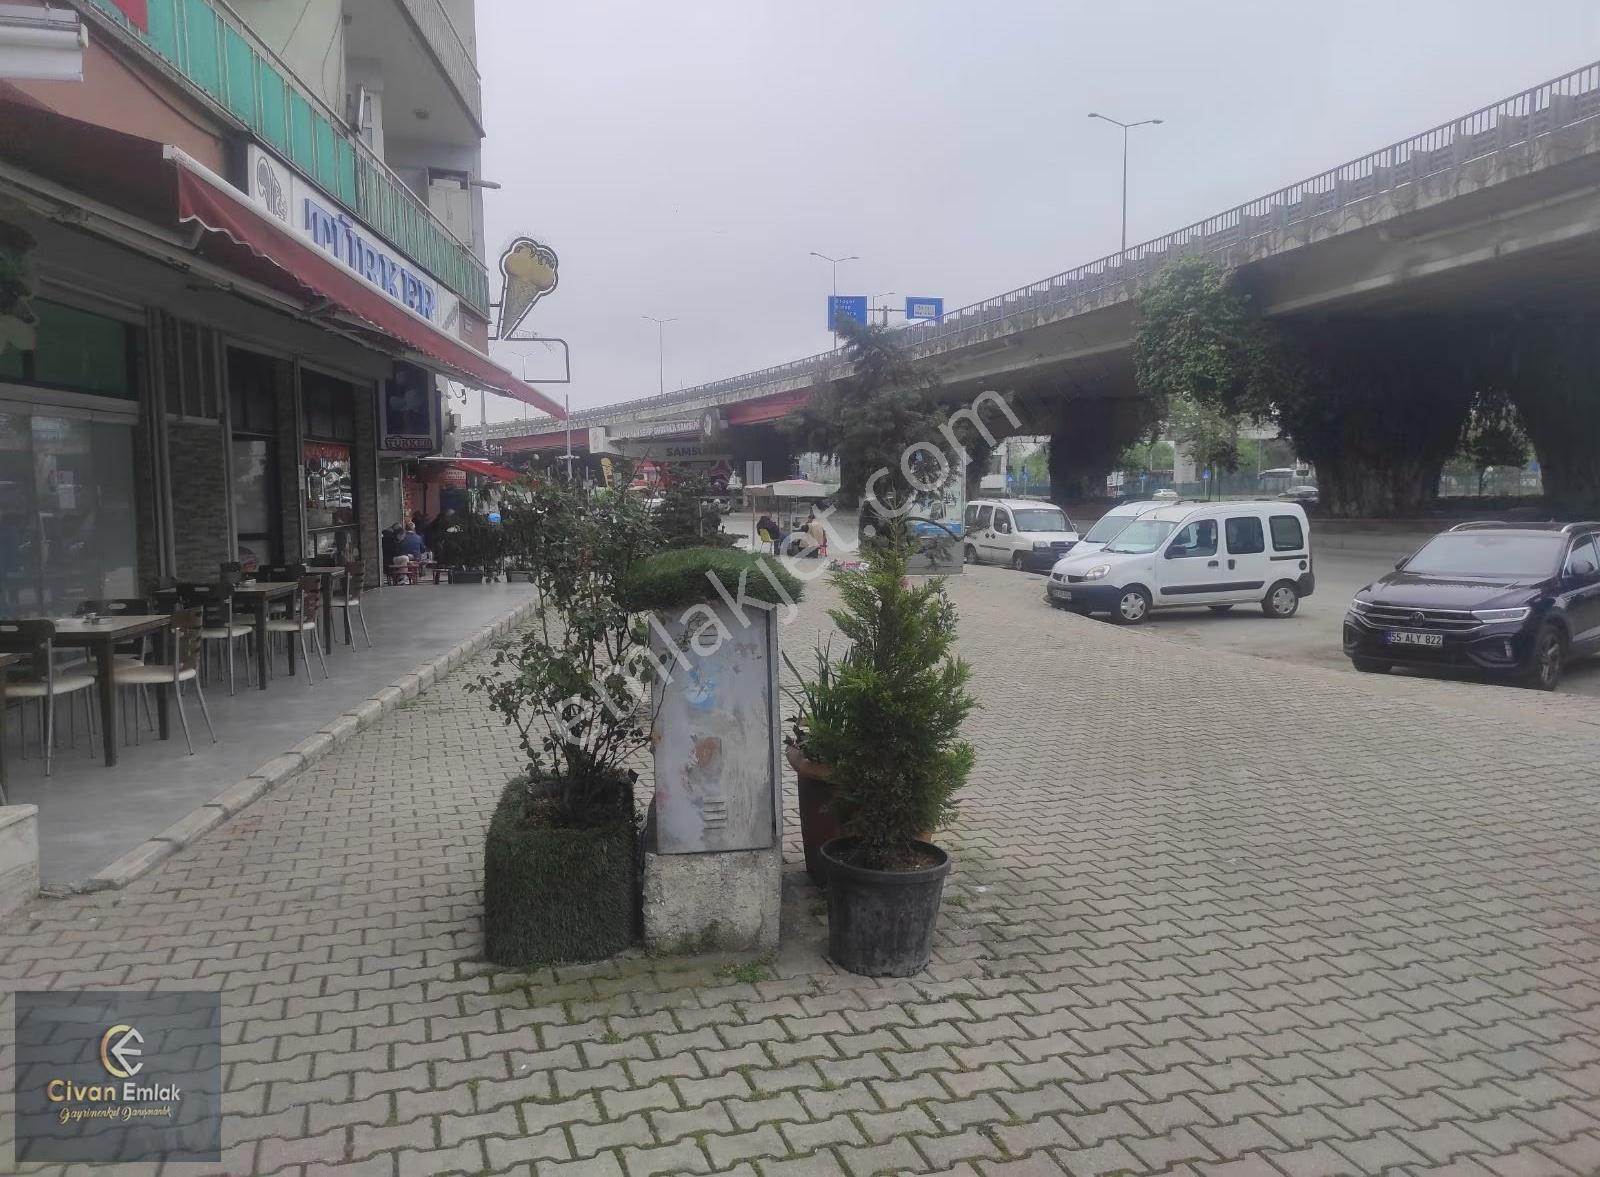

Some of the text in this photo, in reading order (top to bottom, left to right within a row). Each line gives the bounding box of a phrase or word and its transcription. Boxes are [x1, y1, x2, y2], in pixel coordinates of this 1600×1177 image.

[1392, 633, 1442, 645] 55 ALY 822
